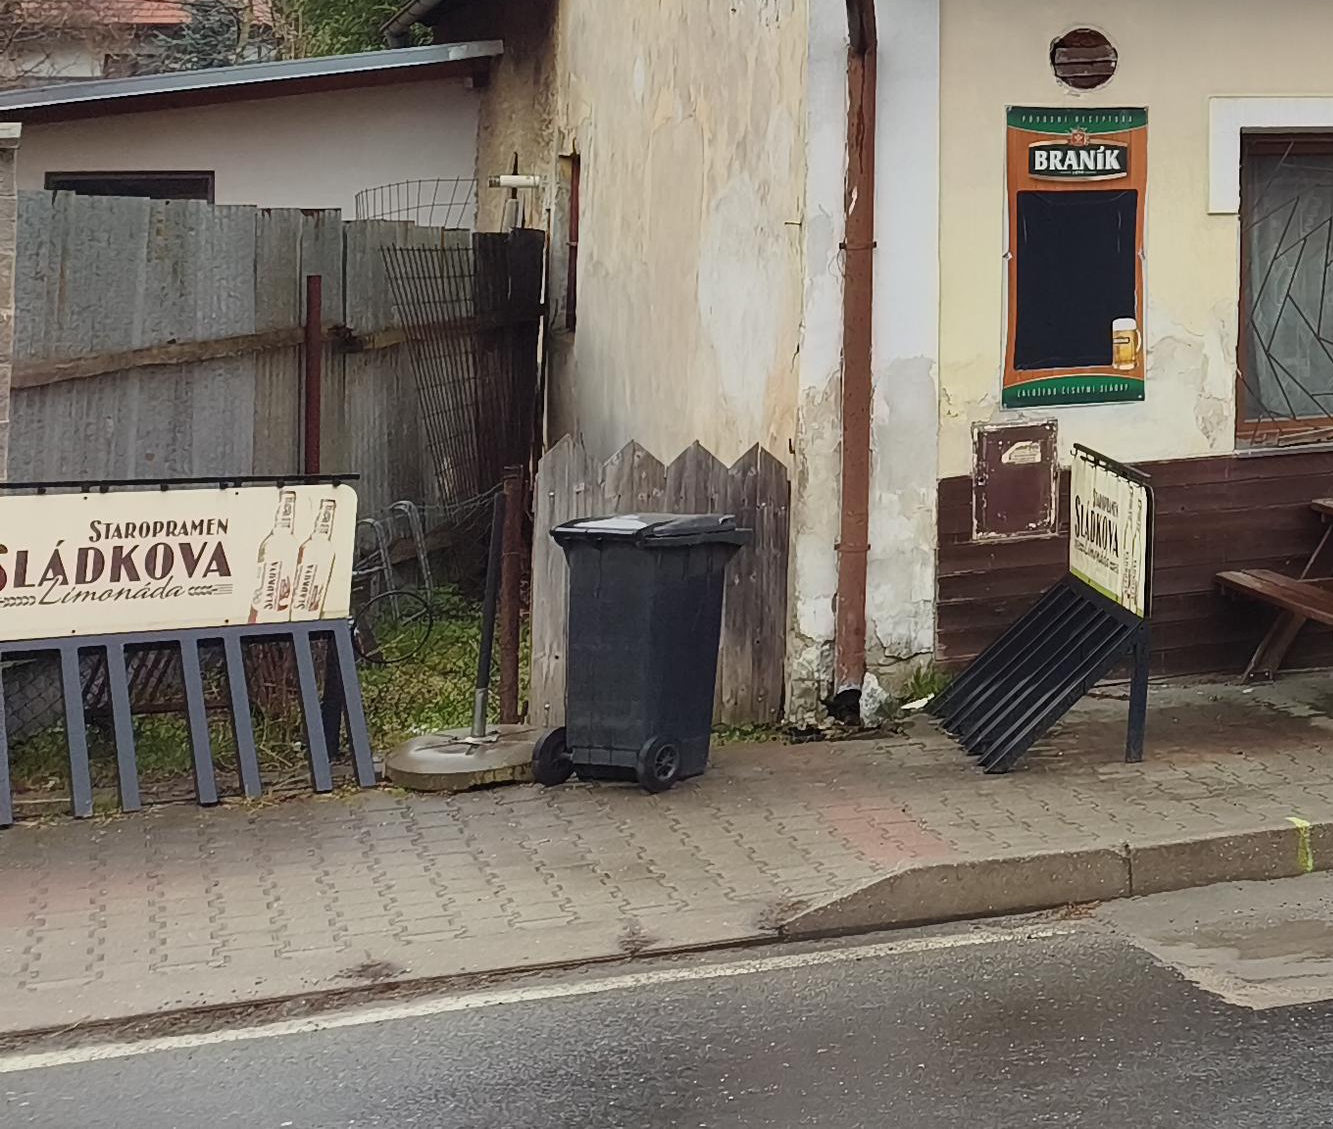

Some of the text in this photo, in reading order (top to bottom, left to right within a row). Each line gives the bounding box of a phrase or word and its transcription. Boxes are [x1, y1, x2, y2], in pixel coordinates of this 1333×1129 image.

[1034, 145, 1121, 171] BRANÍK
[88, 519, 229, 542] STAROPRAMEN
[38, 574, 186, 605] Limonáda
